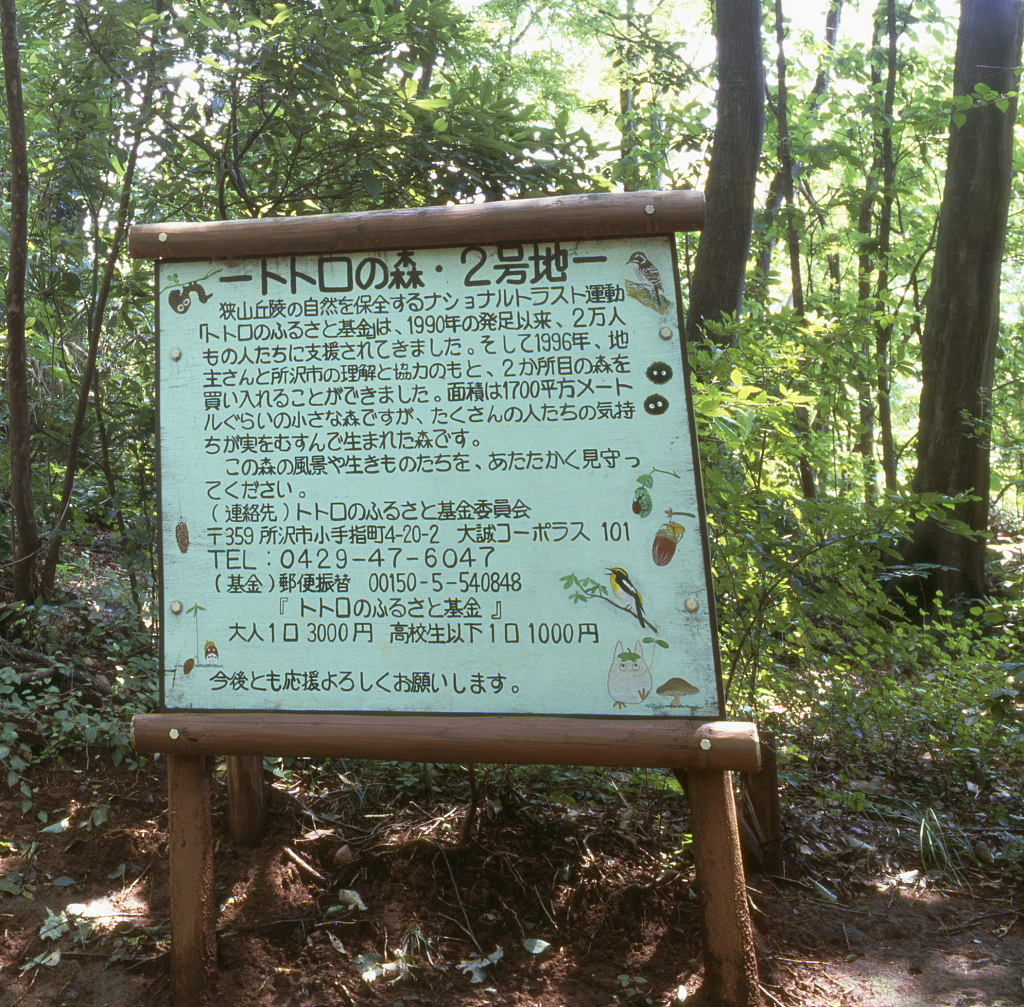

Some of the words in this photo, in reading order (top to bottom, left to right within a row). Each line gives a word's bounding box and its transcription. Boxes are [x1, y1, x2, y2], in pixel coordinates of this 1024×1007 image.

[219, 283, 626, 321] 狭山丘陵の自然を保全するナショナルトラスト運動
[204, 400, 636, 431] ルぐらいの小さな森ですが、たくさんの人たちの気持
[204, 428, 480, 455] ちが実をむすんで生まれた森です。
[225, 448, 641, 477] この森の風景や生きものたちを、あたたかく見守っ
[205, 479, 307, 500] てください。
[601, 521, 631, 542] 101
[368, 571, 523, 593] 00150-5-540848
[209, 669, 520, 694] 今後とも応援よろしくお願いします。
